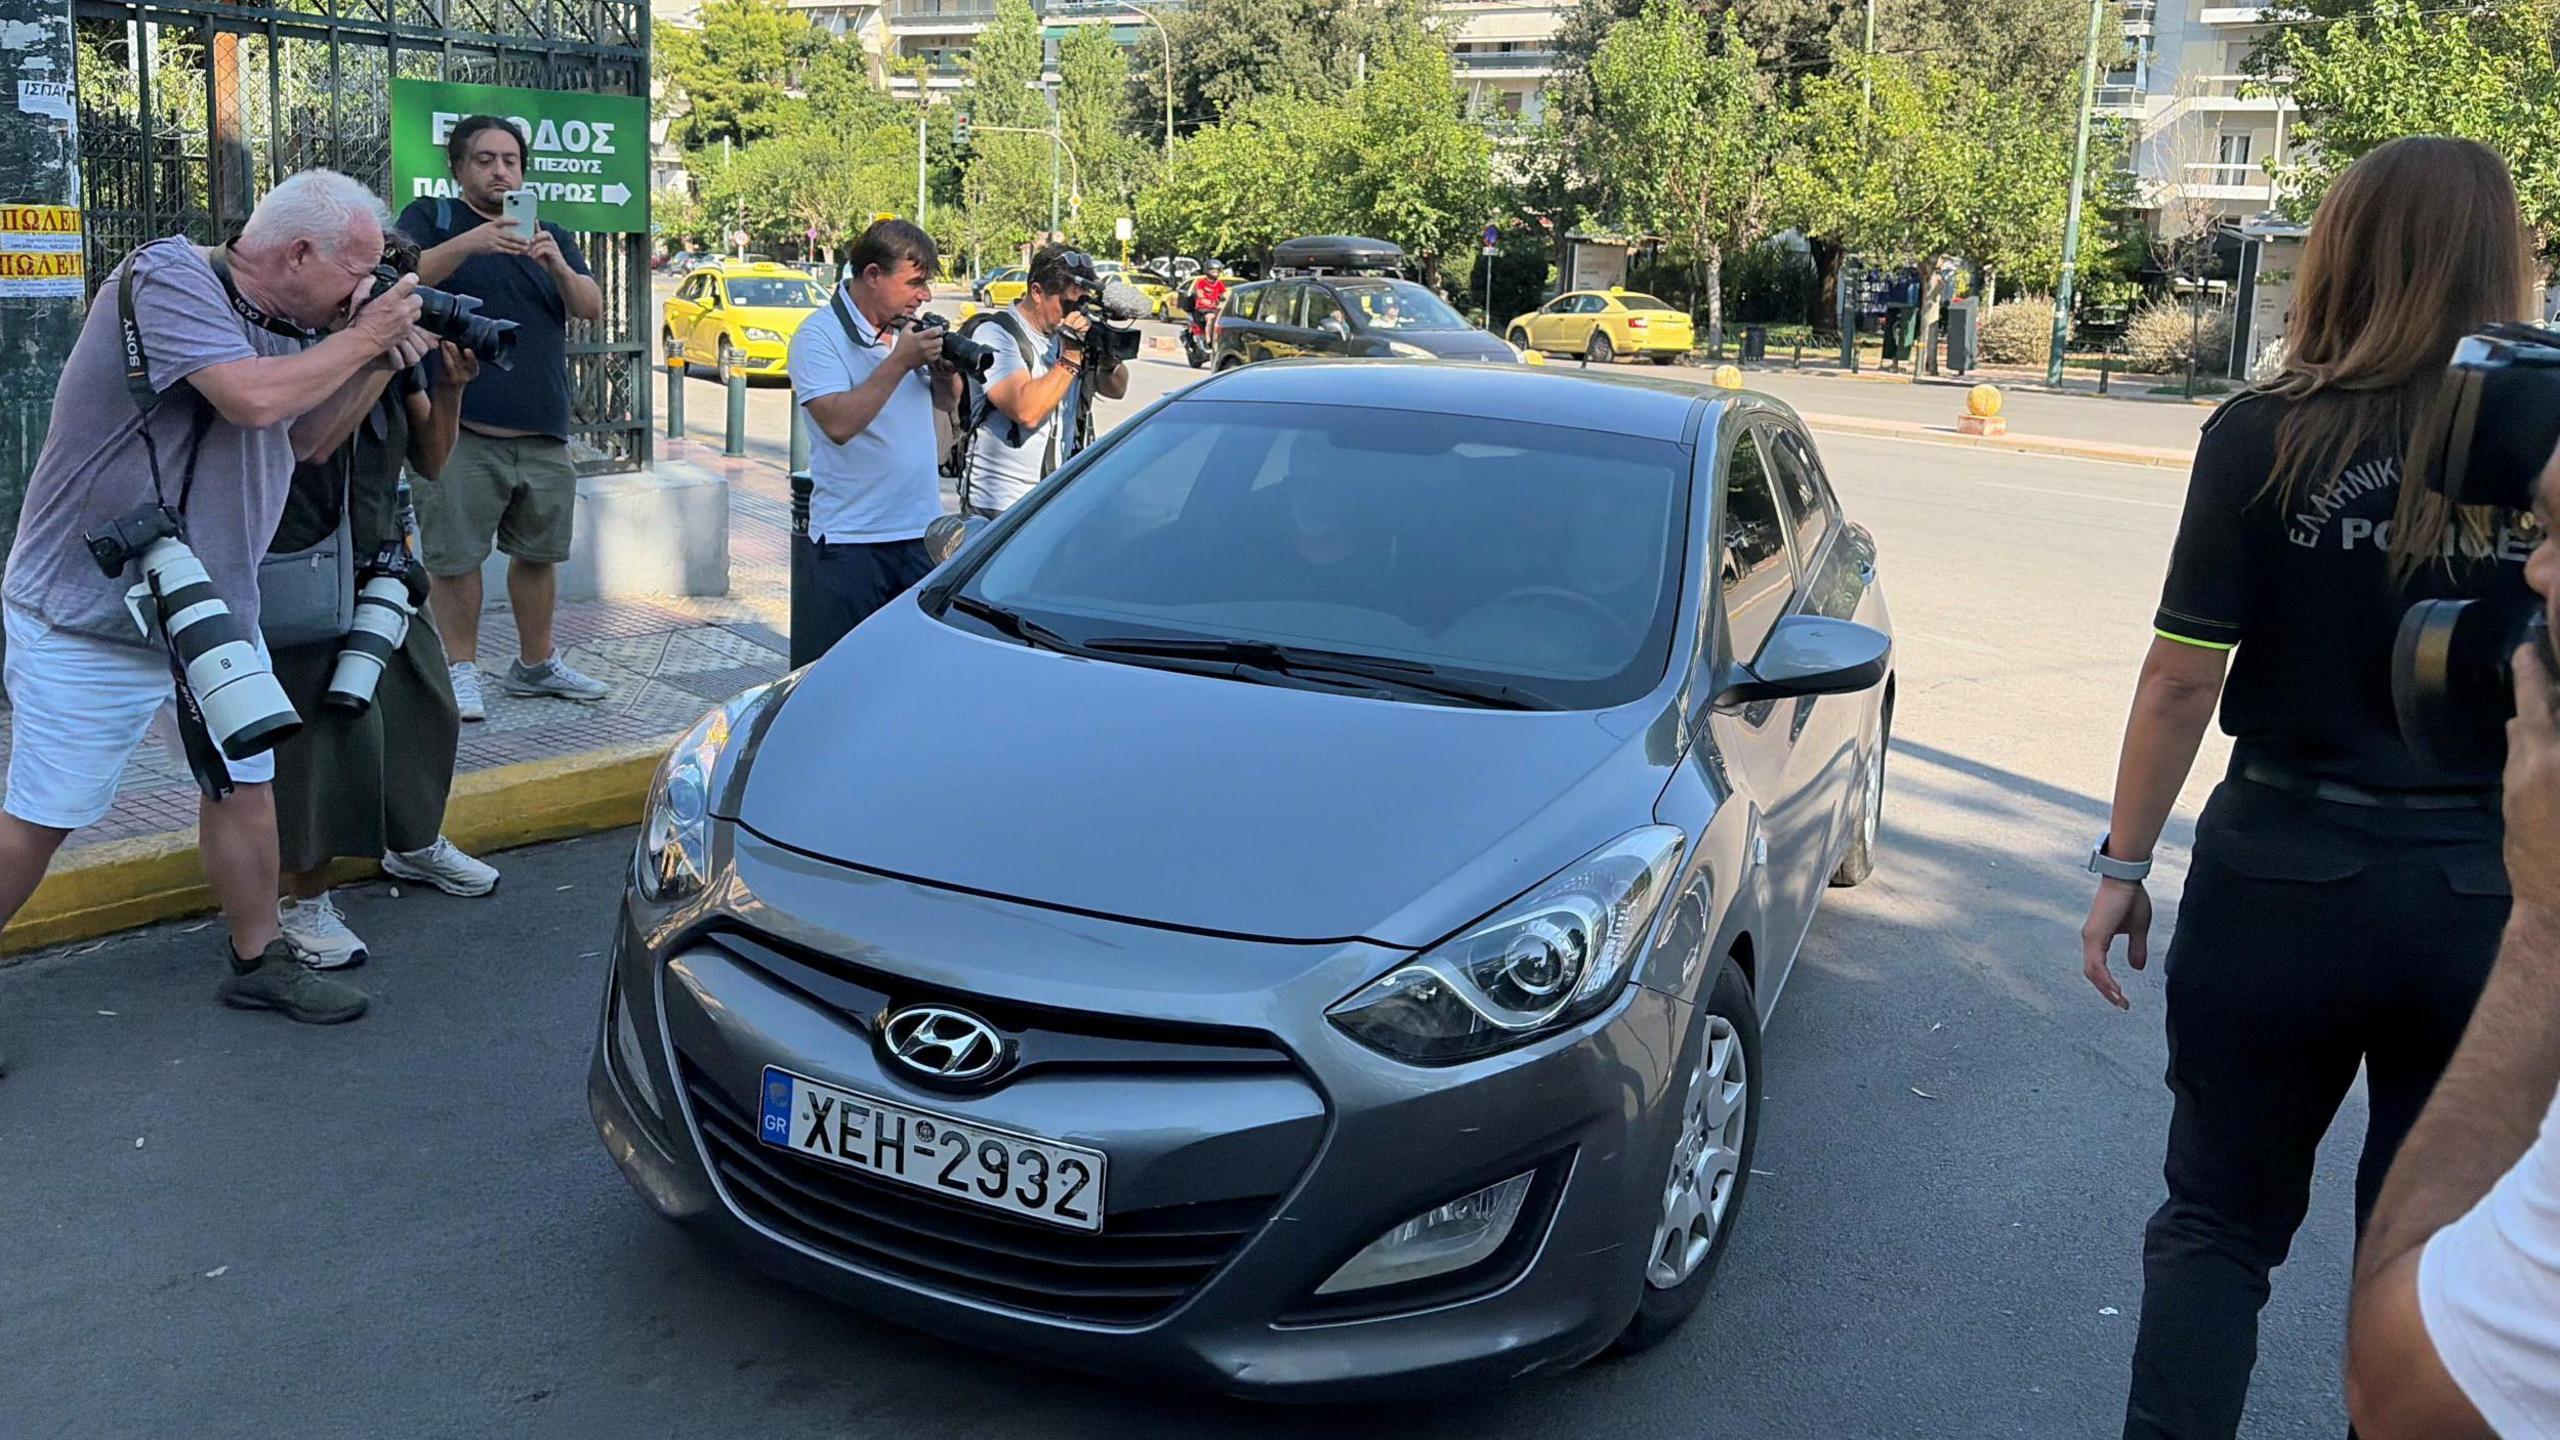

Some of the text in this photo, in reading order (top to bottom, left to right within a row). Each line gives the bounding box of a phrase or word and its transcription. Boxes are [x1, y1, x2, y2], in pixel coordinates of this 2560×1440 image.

[534, 157, 602, 174] ΠΕΖΟΥΣ
[123, 317, 141, 367] SONY
[2341, 517, 2541, 562] POICE
[764, 1091, 1090, 1222] GR XEH-2932
